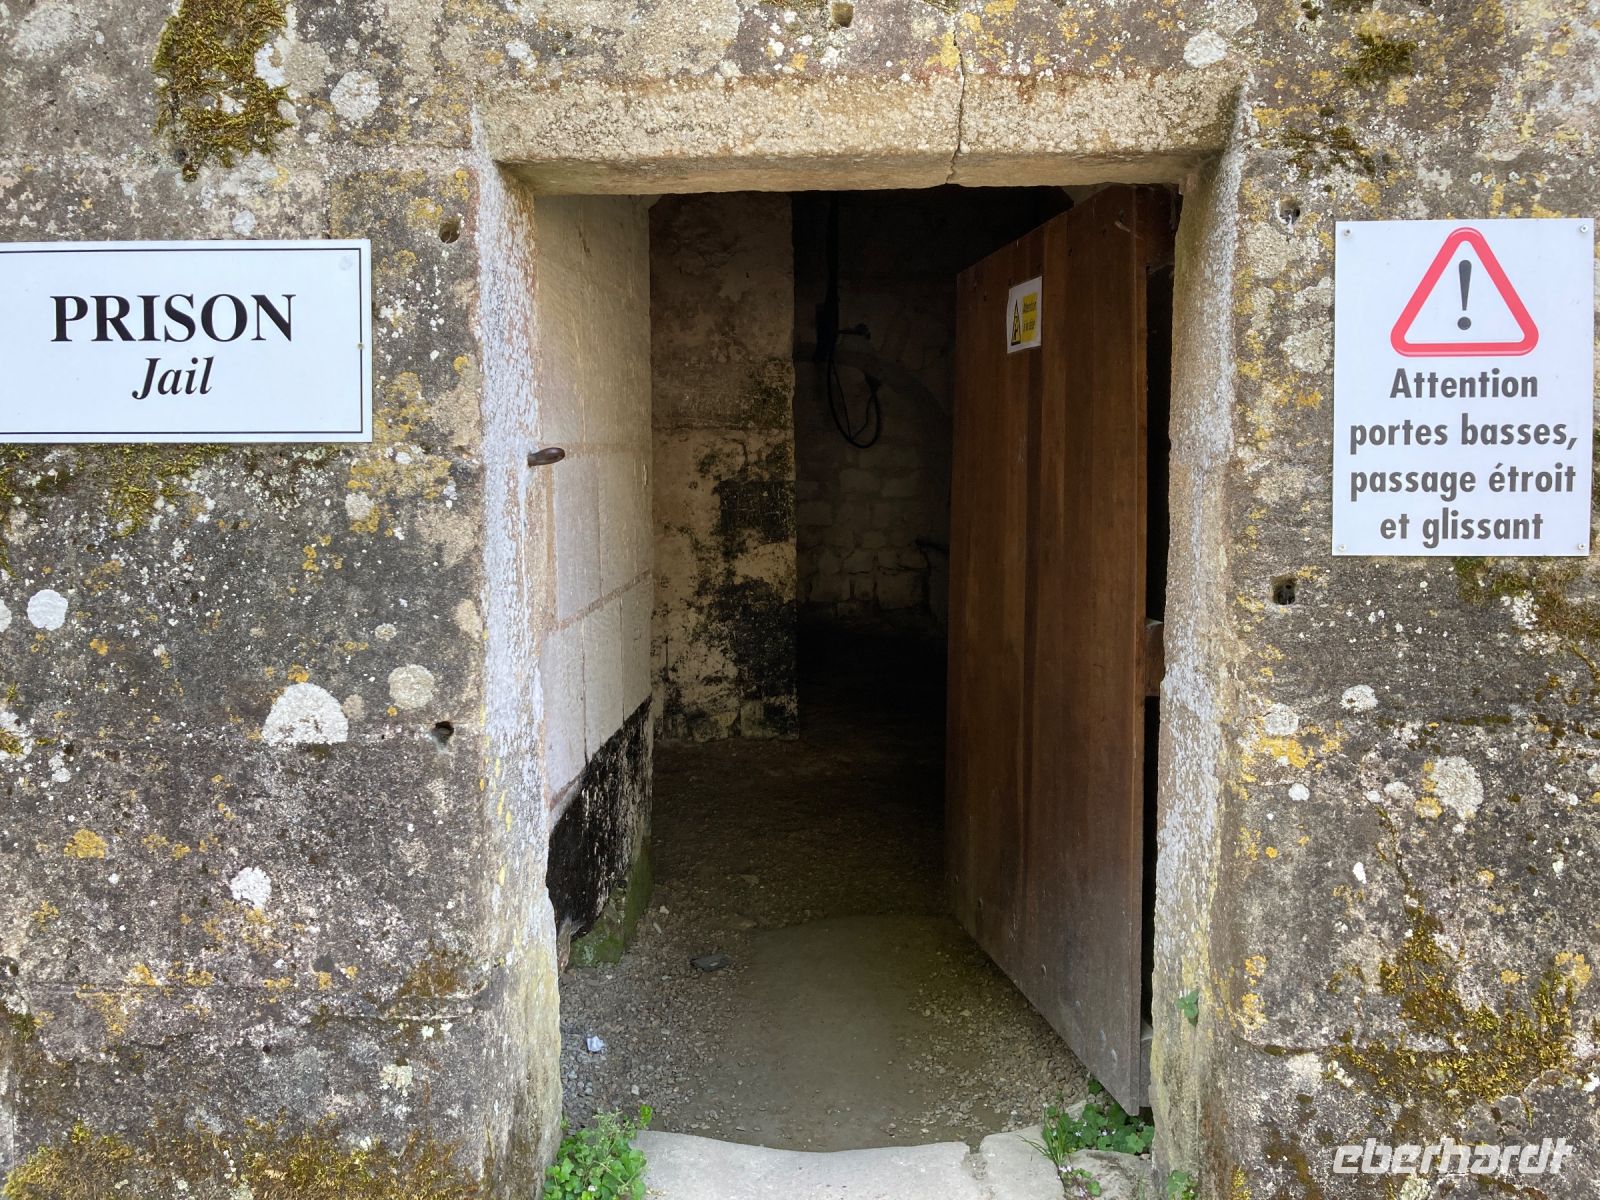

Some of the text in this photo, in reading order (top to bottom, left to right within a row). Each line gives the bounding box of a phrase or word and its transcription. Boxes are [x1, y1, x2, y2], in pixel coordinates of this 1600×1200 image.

[50, 293, 297, 343] PRISON
[131, 356, 215, 400] Jail
[1389, 367, 1539, 399] Attention
[1350, 412, 1578, 455] portes basses,
[1350, 462, 1577, 502] passage étroit
[1380, 507, 1544, 549] et glissant
